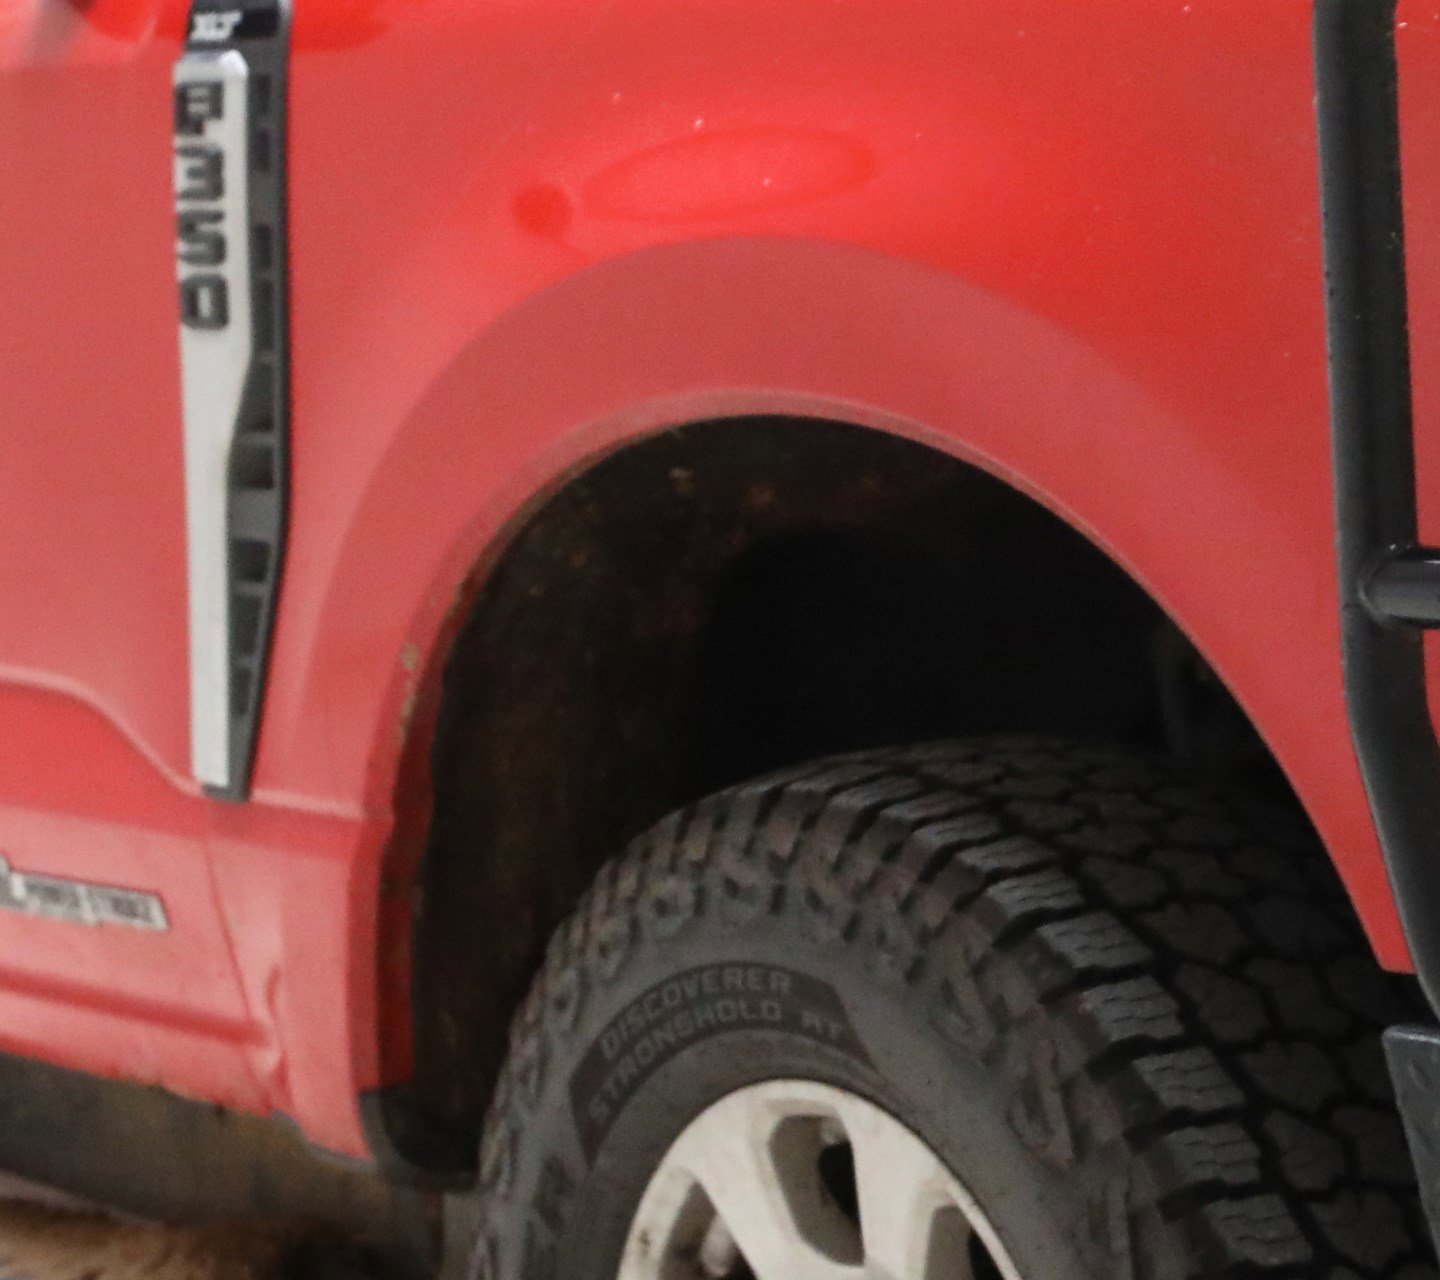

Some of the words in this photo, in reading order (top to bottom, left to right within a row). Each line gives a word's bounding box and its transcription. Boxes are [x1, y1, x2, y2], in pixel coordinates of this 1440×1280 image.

[190, 10, 244, 41] XLT
[588, 998, 783, 1126] STRONGHOLD
[600, 966, 792, 1062] DISCOVERER
